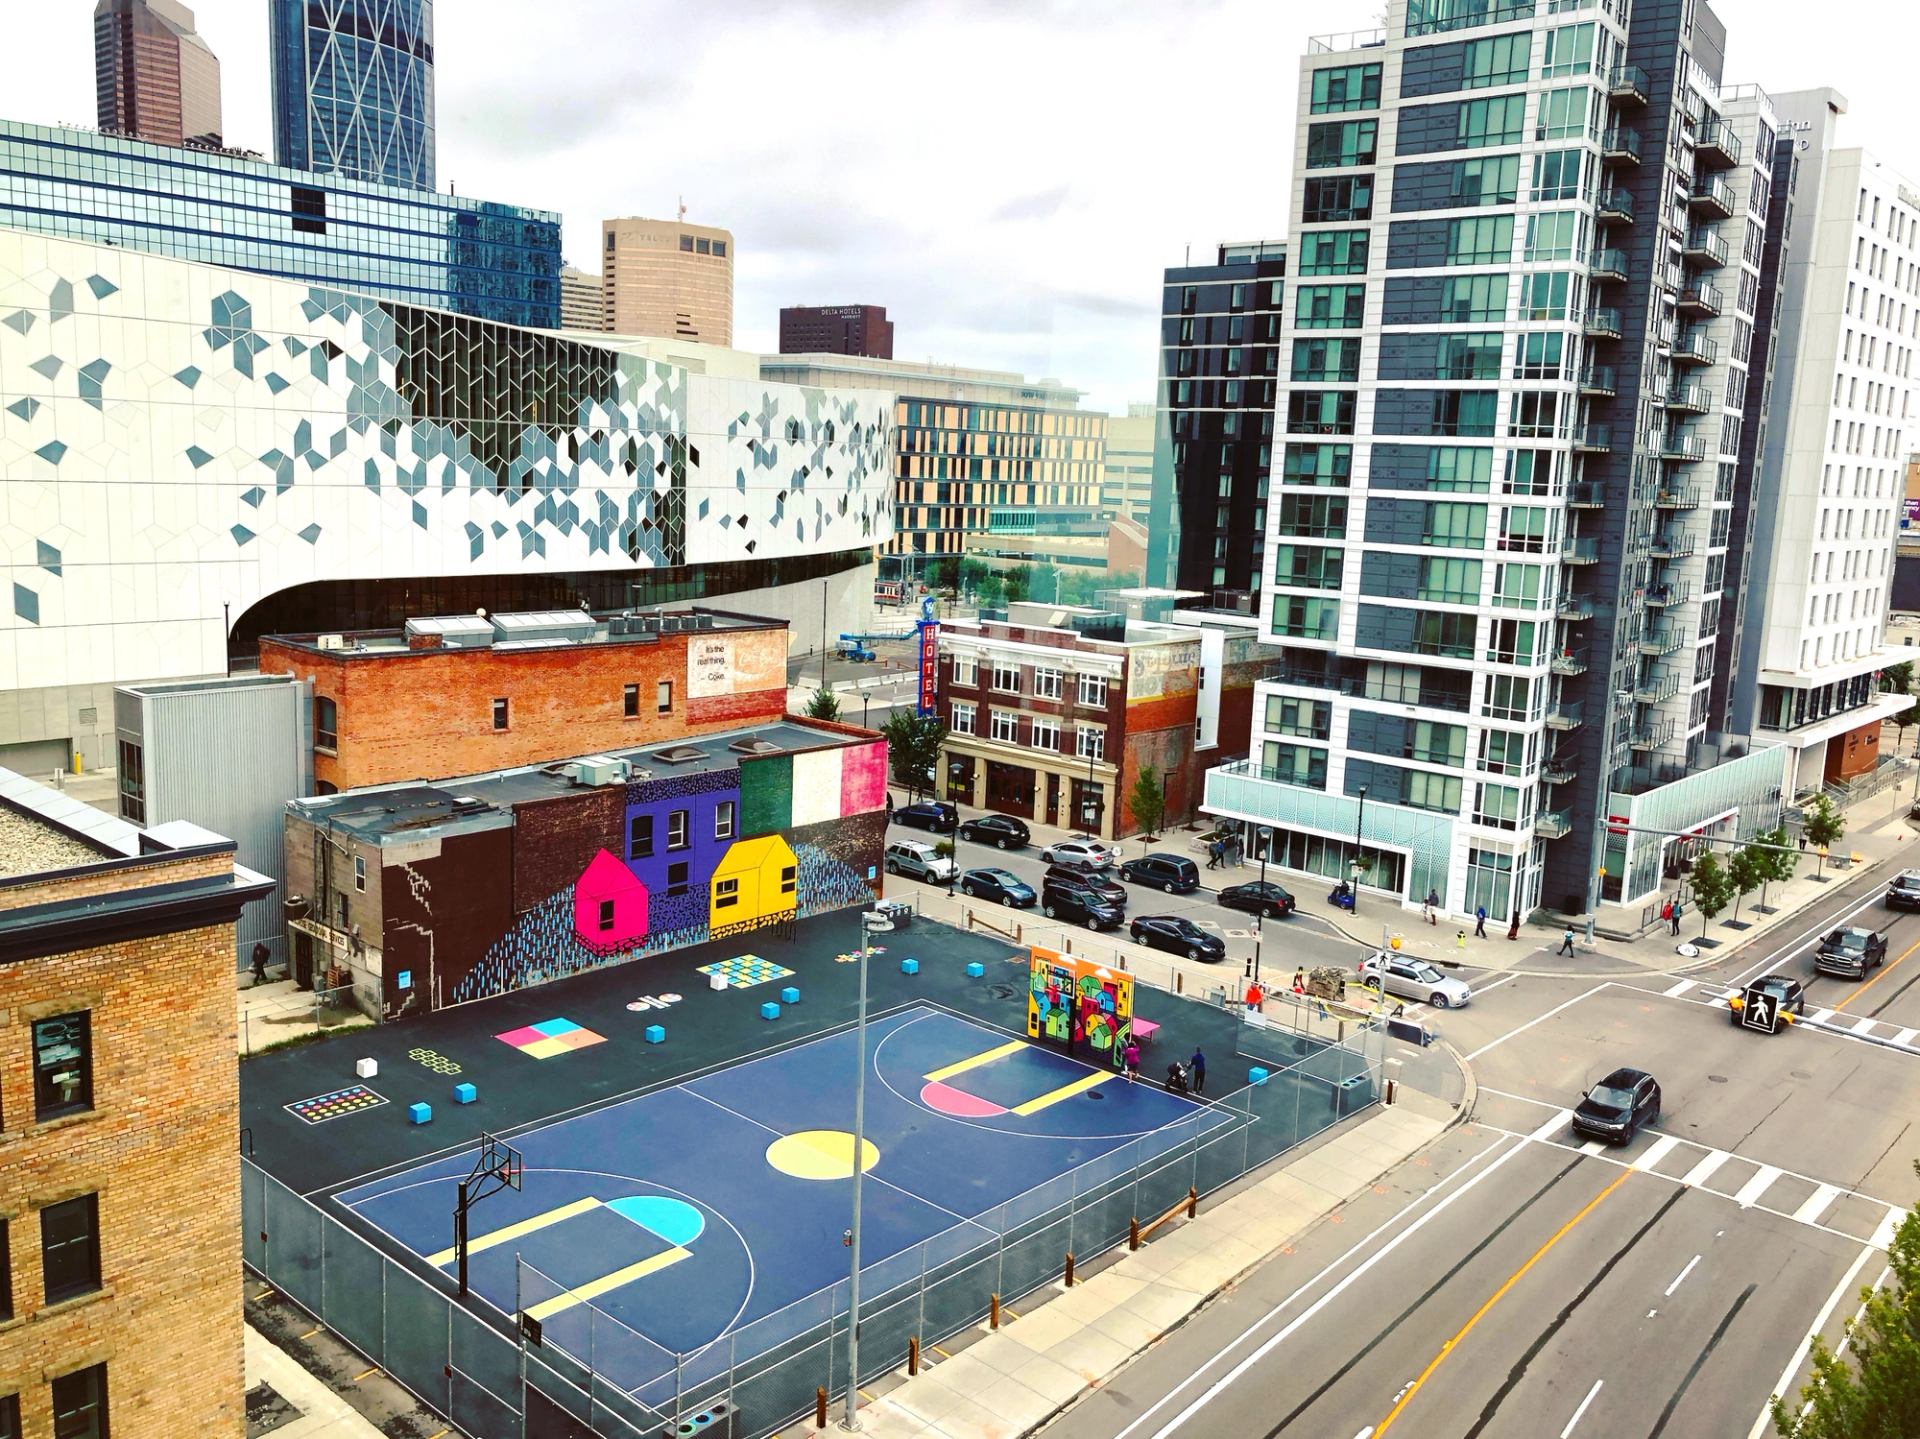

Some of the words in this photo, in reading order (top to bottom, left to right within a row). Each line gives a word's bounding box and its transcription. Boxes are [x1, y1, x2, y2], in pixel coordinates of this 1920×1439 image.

[839, 307, 861, 315] HOTELS
[714, 645, 725, 653] the
[925, 628, 934, 708] HOTEL
